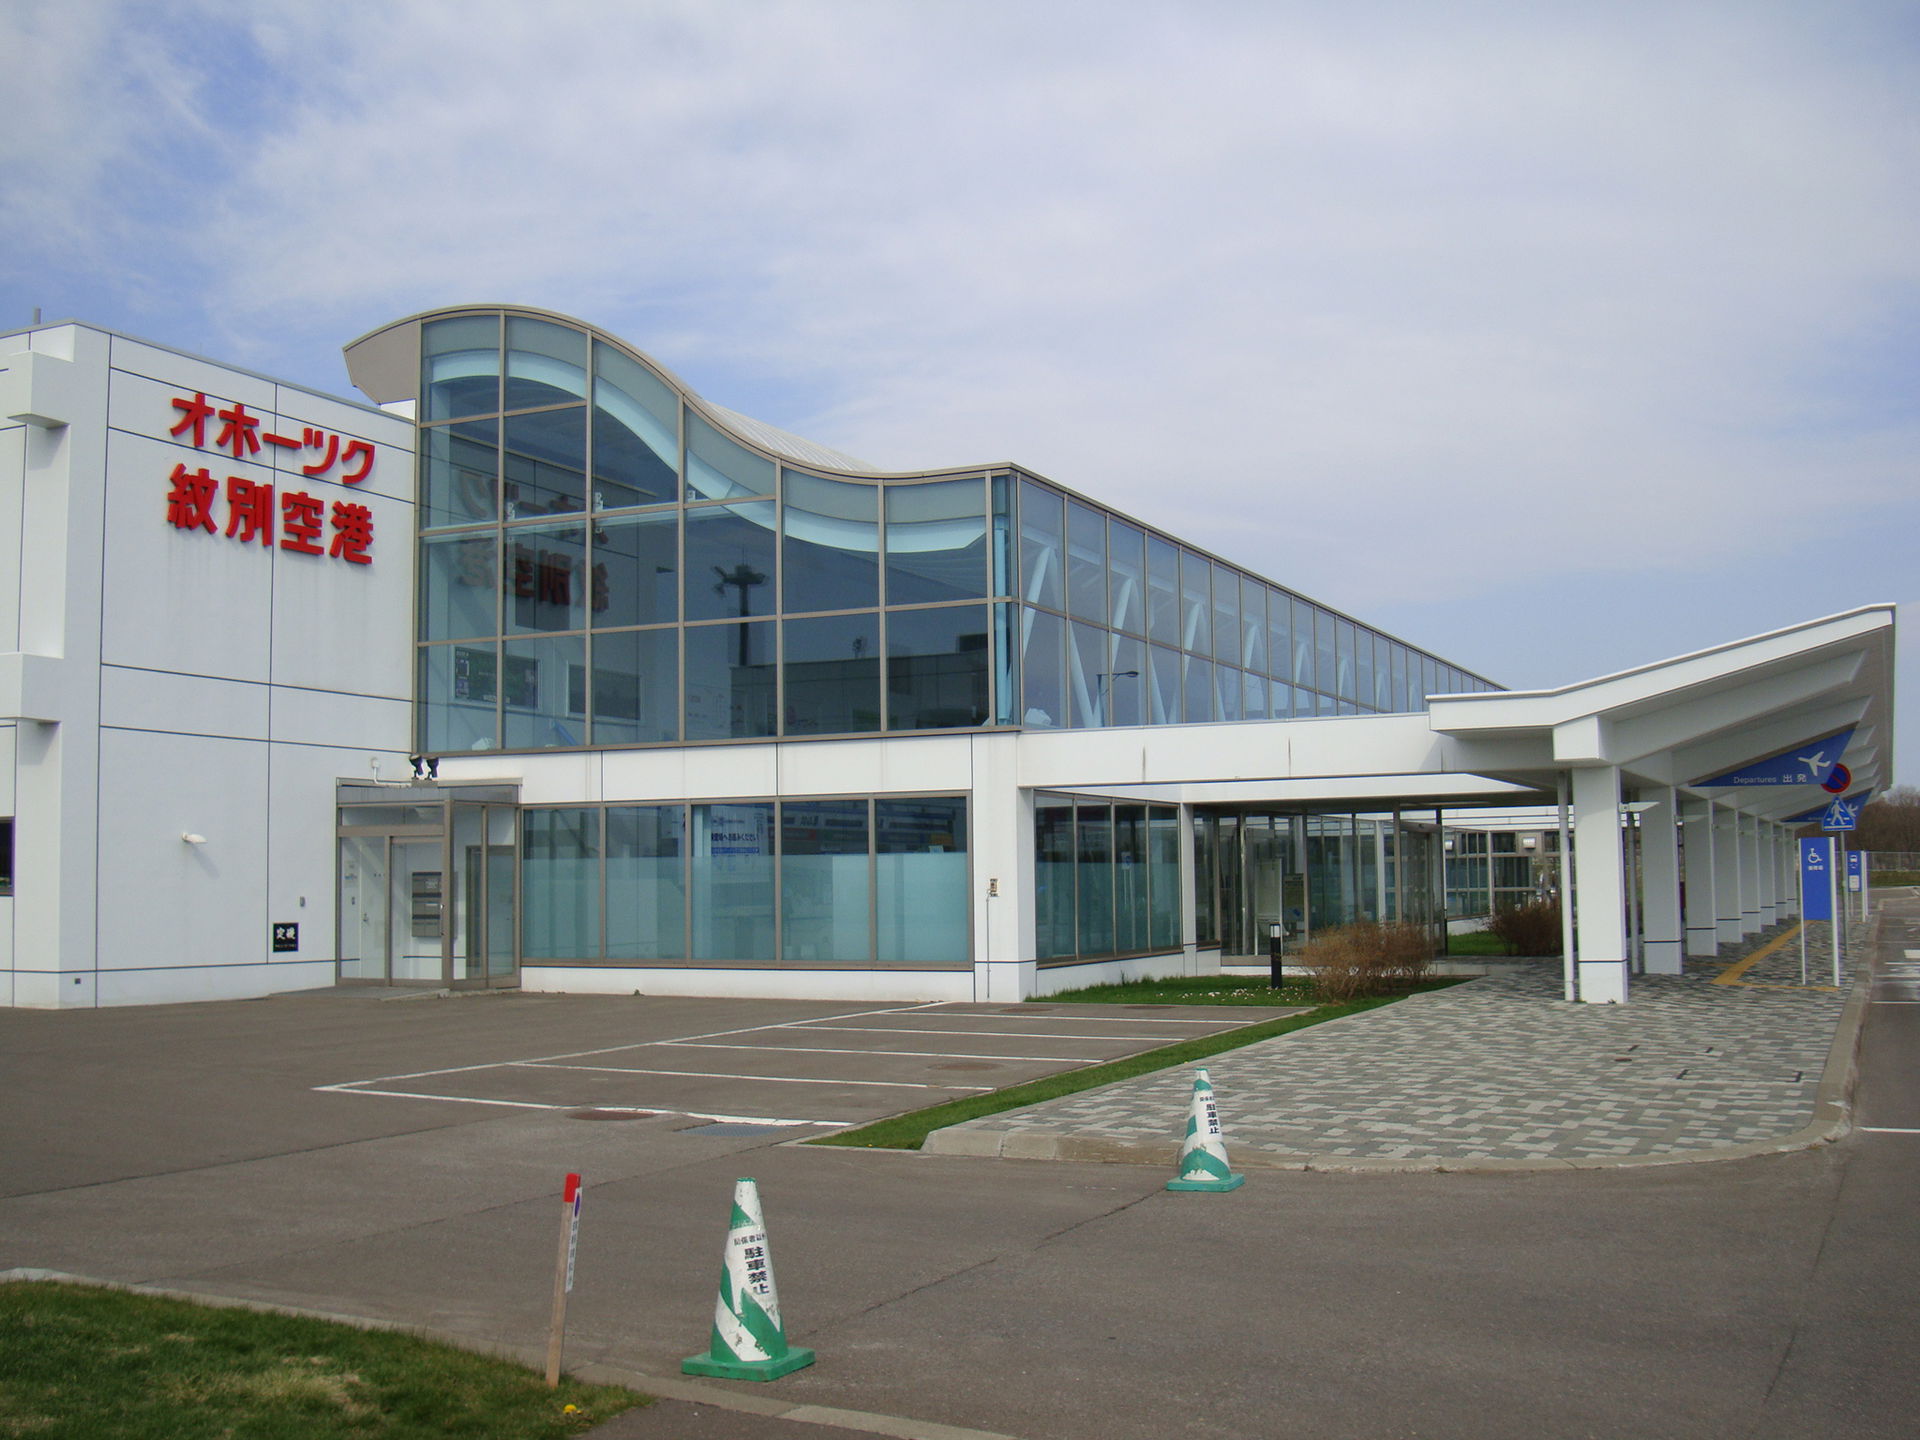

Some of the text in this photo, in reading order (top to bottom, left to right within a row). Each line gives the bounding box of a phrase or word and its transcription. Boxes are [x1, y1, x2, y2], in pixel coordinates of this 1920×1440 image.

[170, 393, 375, 484] オホーツク
[167, 463, 374, 564] 紋別空港
[1733, 776, 1777, 785] Departures
[744, 1246, 769, 1295] 駐車禁止
